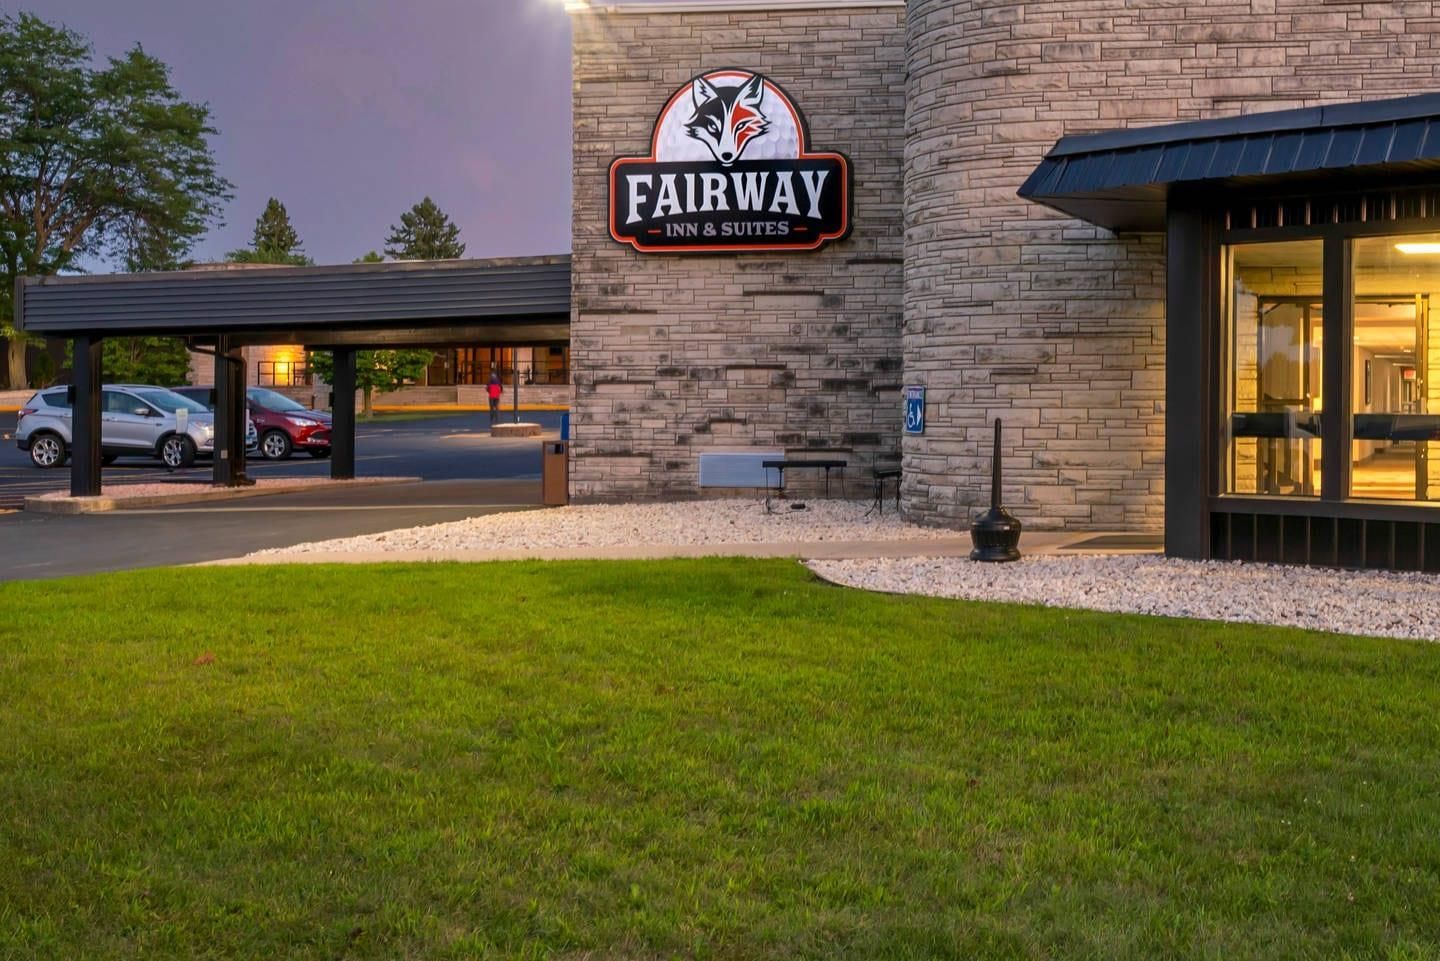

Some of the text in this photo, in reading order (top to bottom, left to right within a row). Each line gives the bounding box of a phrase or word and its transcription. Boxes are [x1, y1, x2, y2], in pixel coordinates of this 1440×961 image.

[625, 170, 830, 225] FAIRWAY
[665, 221, 790, 237] INN & SUITES
